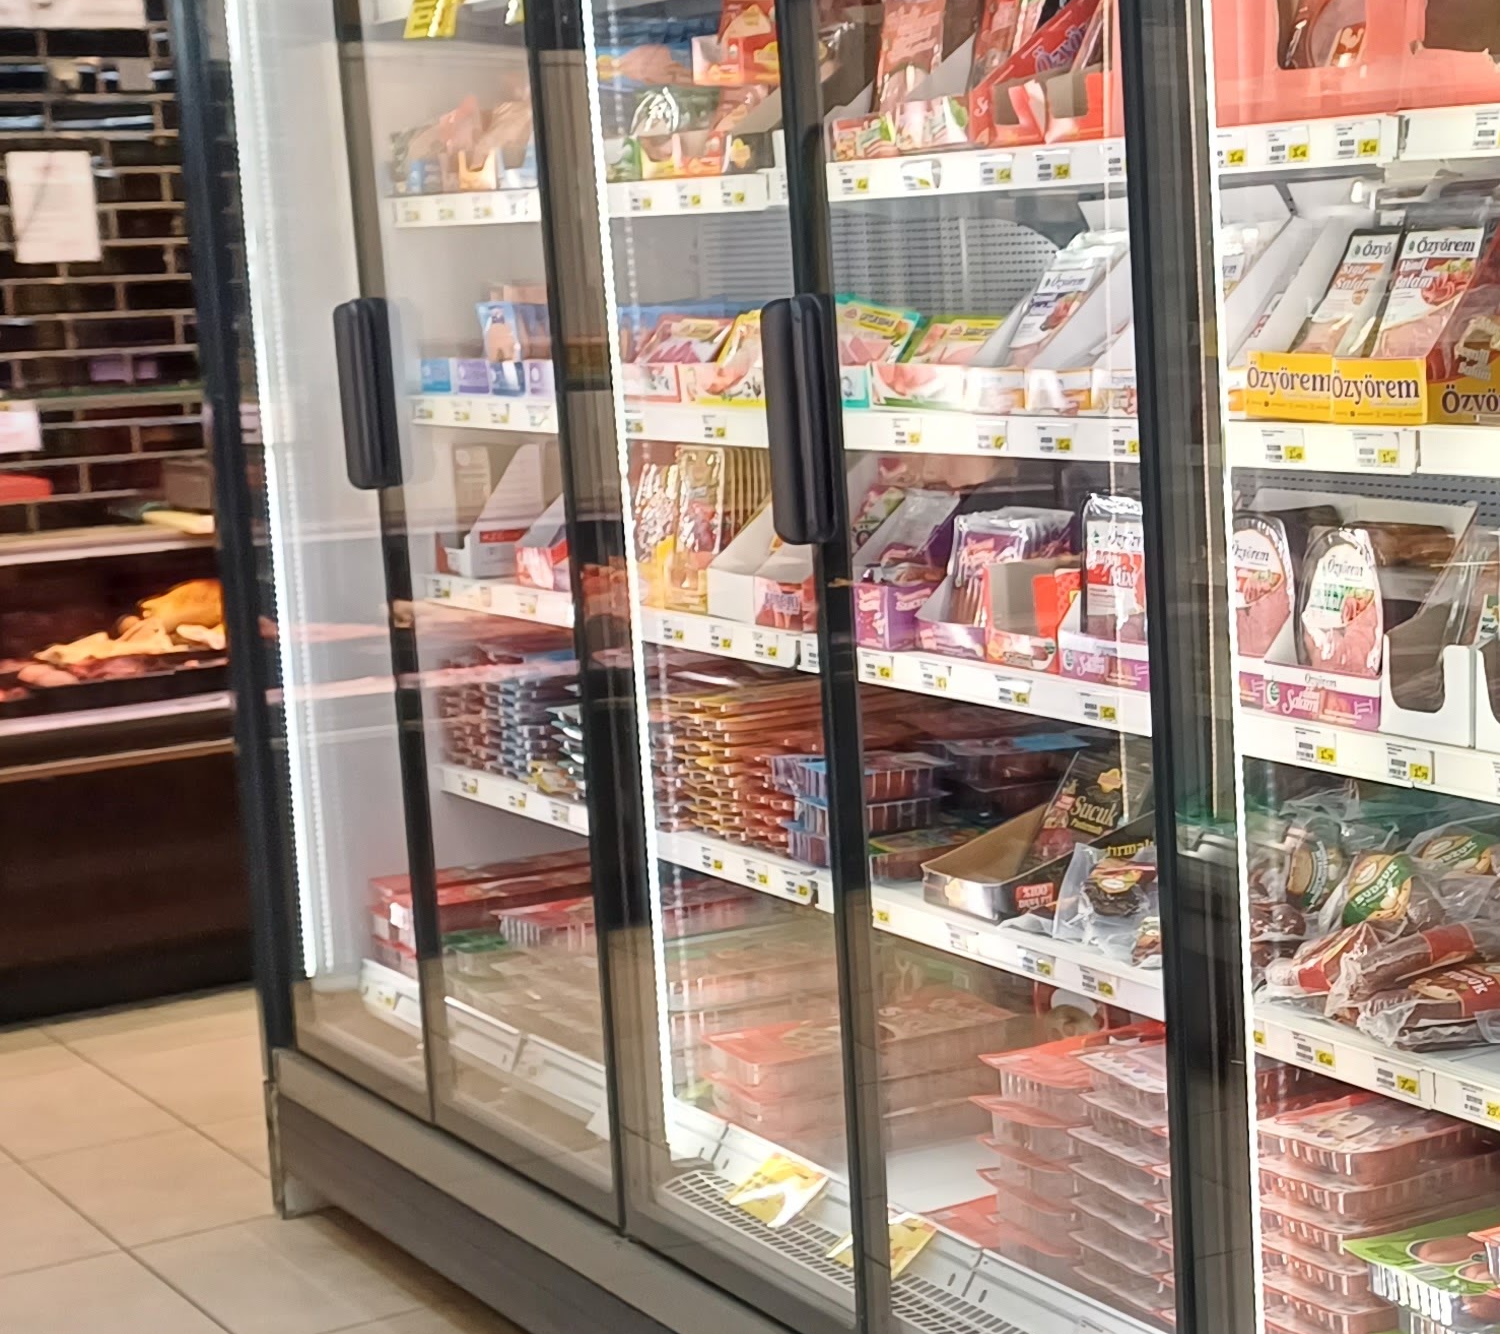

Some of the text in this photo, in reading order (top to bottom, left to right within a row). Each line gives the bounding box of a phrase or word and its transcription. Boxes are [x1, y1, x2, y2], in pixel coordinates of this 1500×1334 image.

[1247, 361, 1330, 400] Özyörem
[1332, 368, 1420, 406] Özyörem
[1070, 795, 1118, 827] Sucuk
